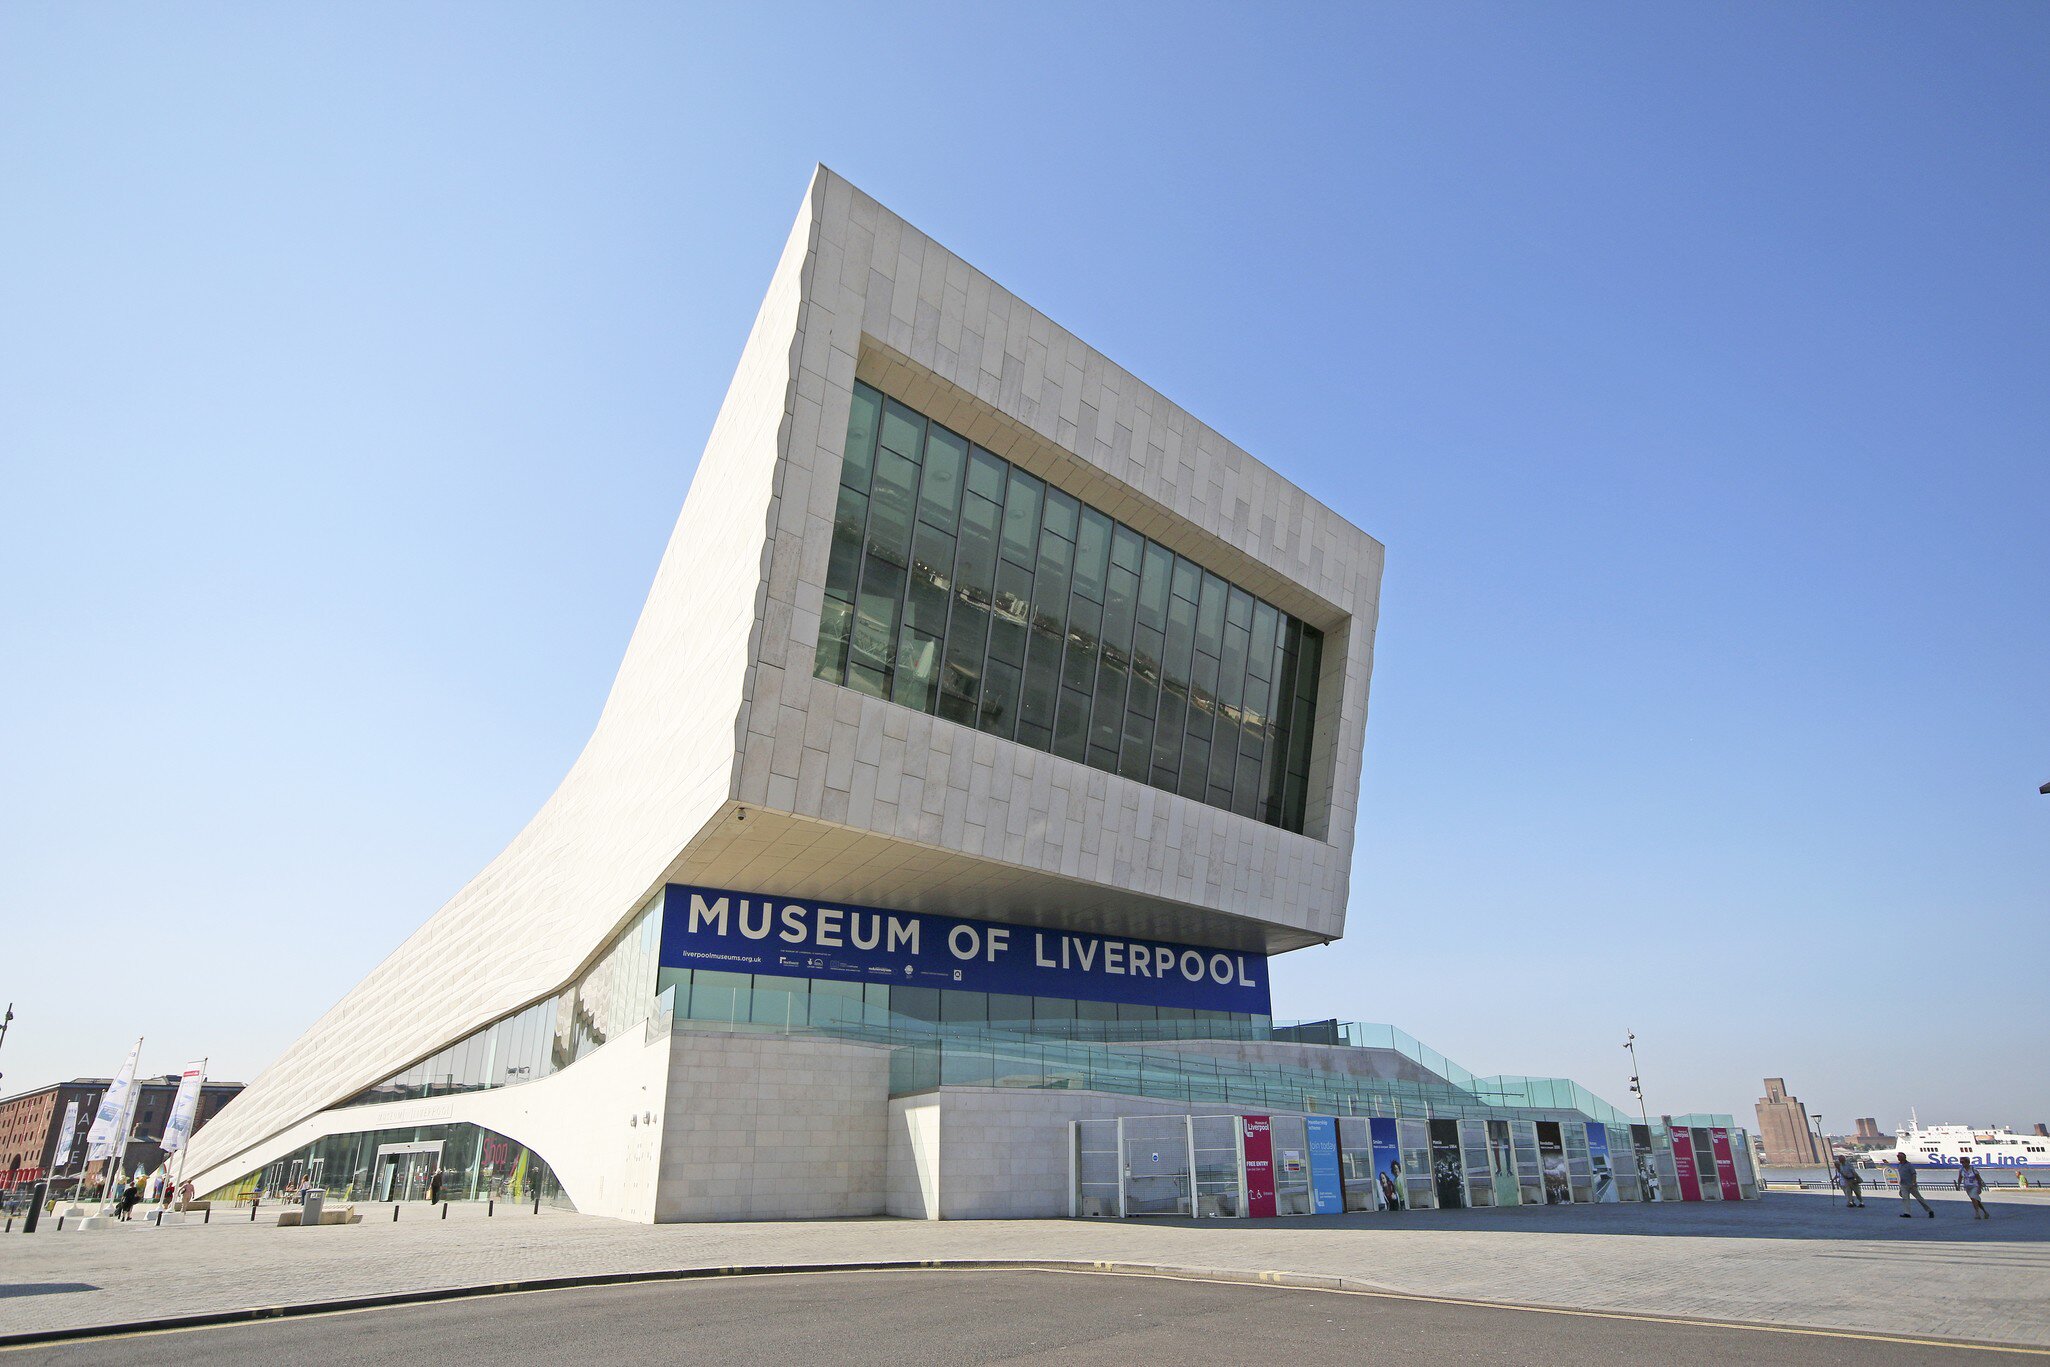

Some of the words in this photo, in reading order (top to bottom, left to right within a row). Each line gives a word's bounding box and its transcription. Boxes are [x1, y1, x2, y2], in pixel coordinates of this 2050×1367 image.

[688, 894, 920, 955] MUSEUM
[948, 924, 1010, 961] OF
[1035, 933, 1256, 987] LIVERPOOL
[682, 950, 762, 963] liverpoolmuseums.org.uk
[70, 1093, 96, 1164] TATE
[1247, 1123, 1270, 1132] Liverpool
[481, 1136, 508, 1172] Shop
[1927, 1153, 1983, 1166] Stea
[1985, 1153, 2028, 1166] Line
